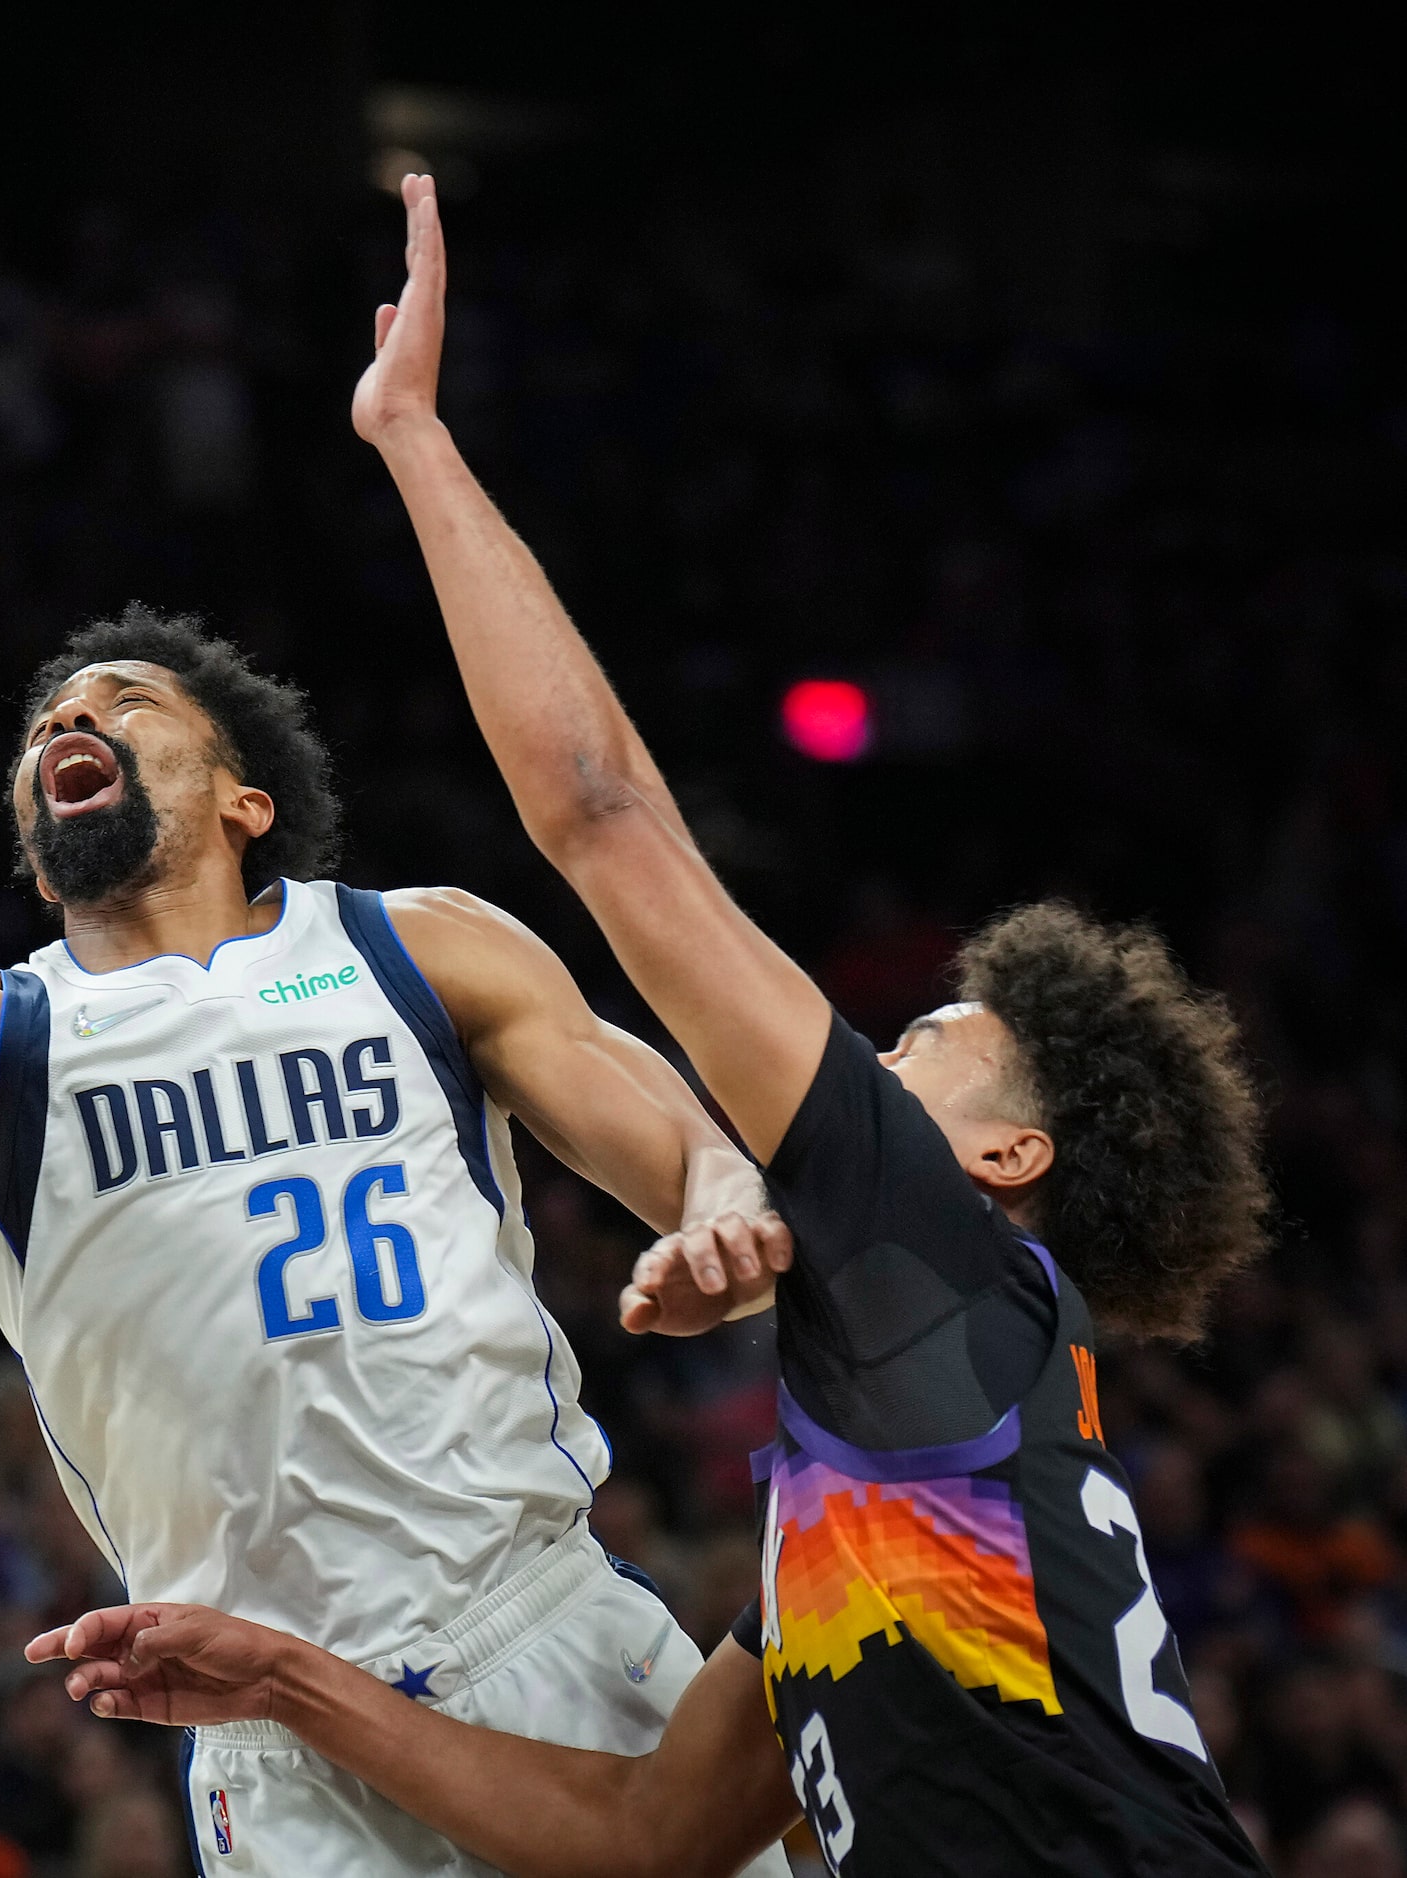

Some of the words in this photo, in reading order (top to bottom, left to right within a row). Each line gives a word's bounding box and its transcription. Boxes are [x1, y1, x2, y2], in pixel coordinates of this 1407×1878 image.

[258, 965, 360, 1004] chime
[73, 1034, 402, 1197] DALLAS
[244, 1160, 427, 1343] 26
